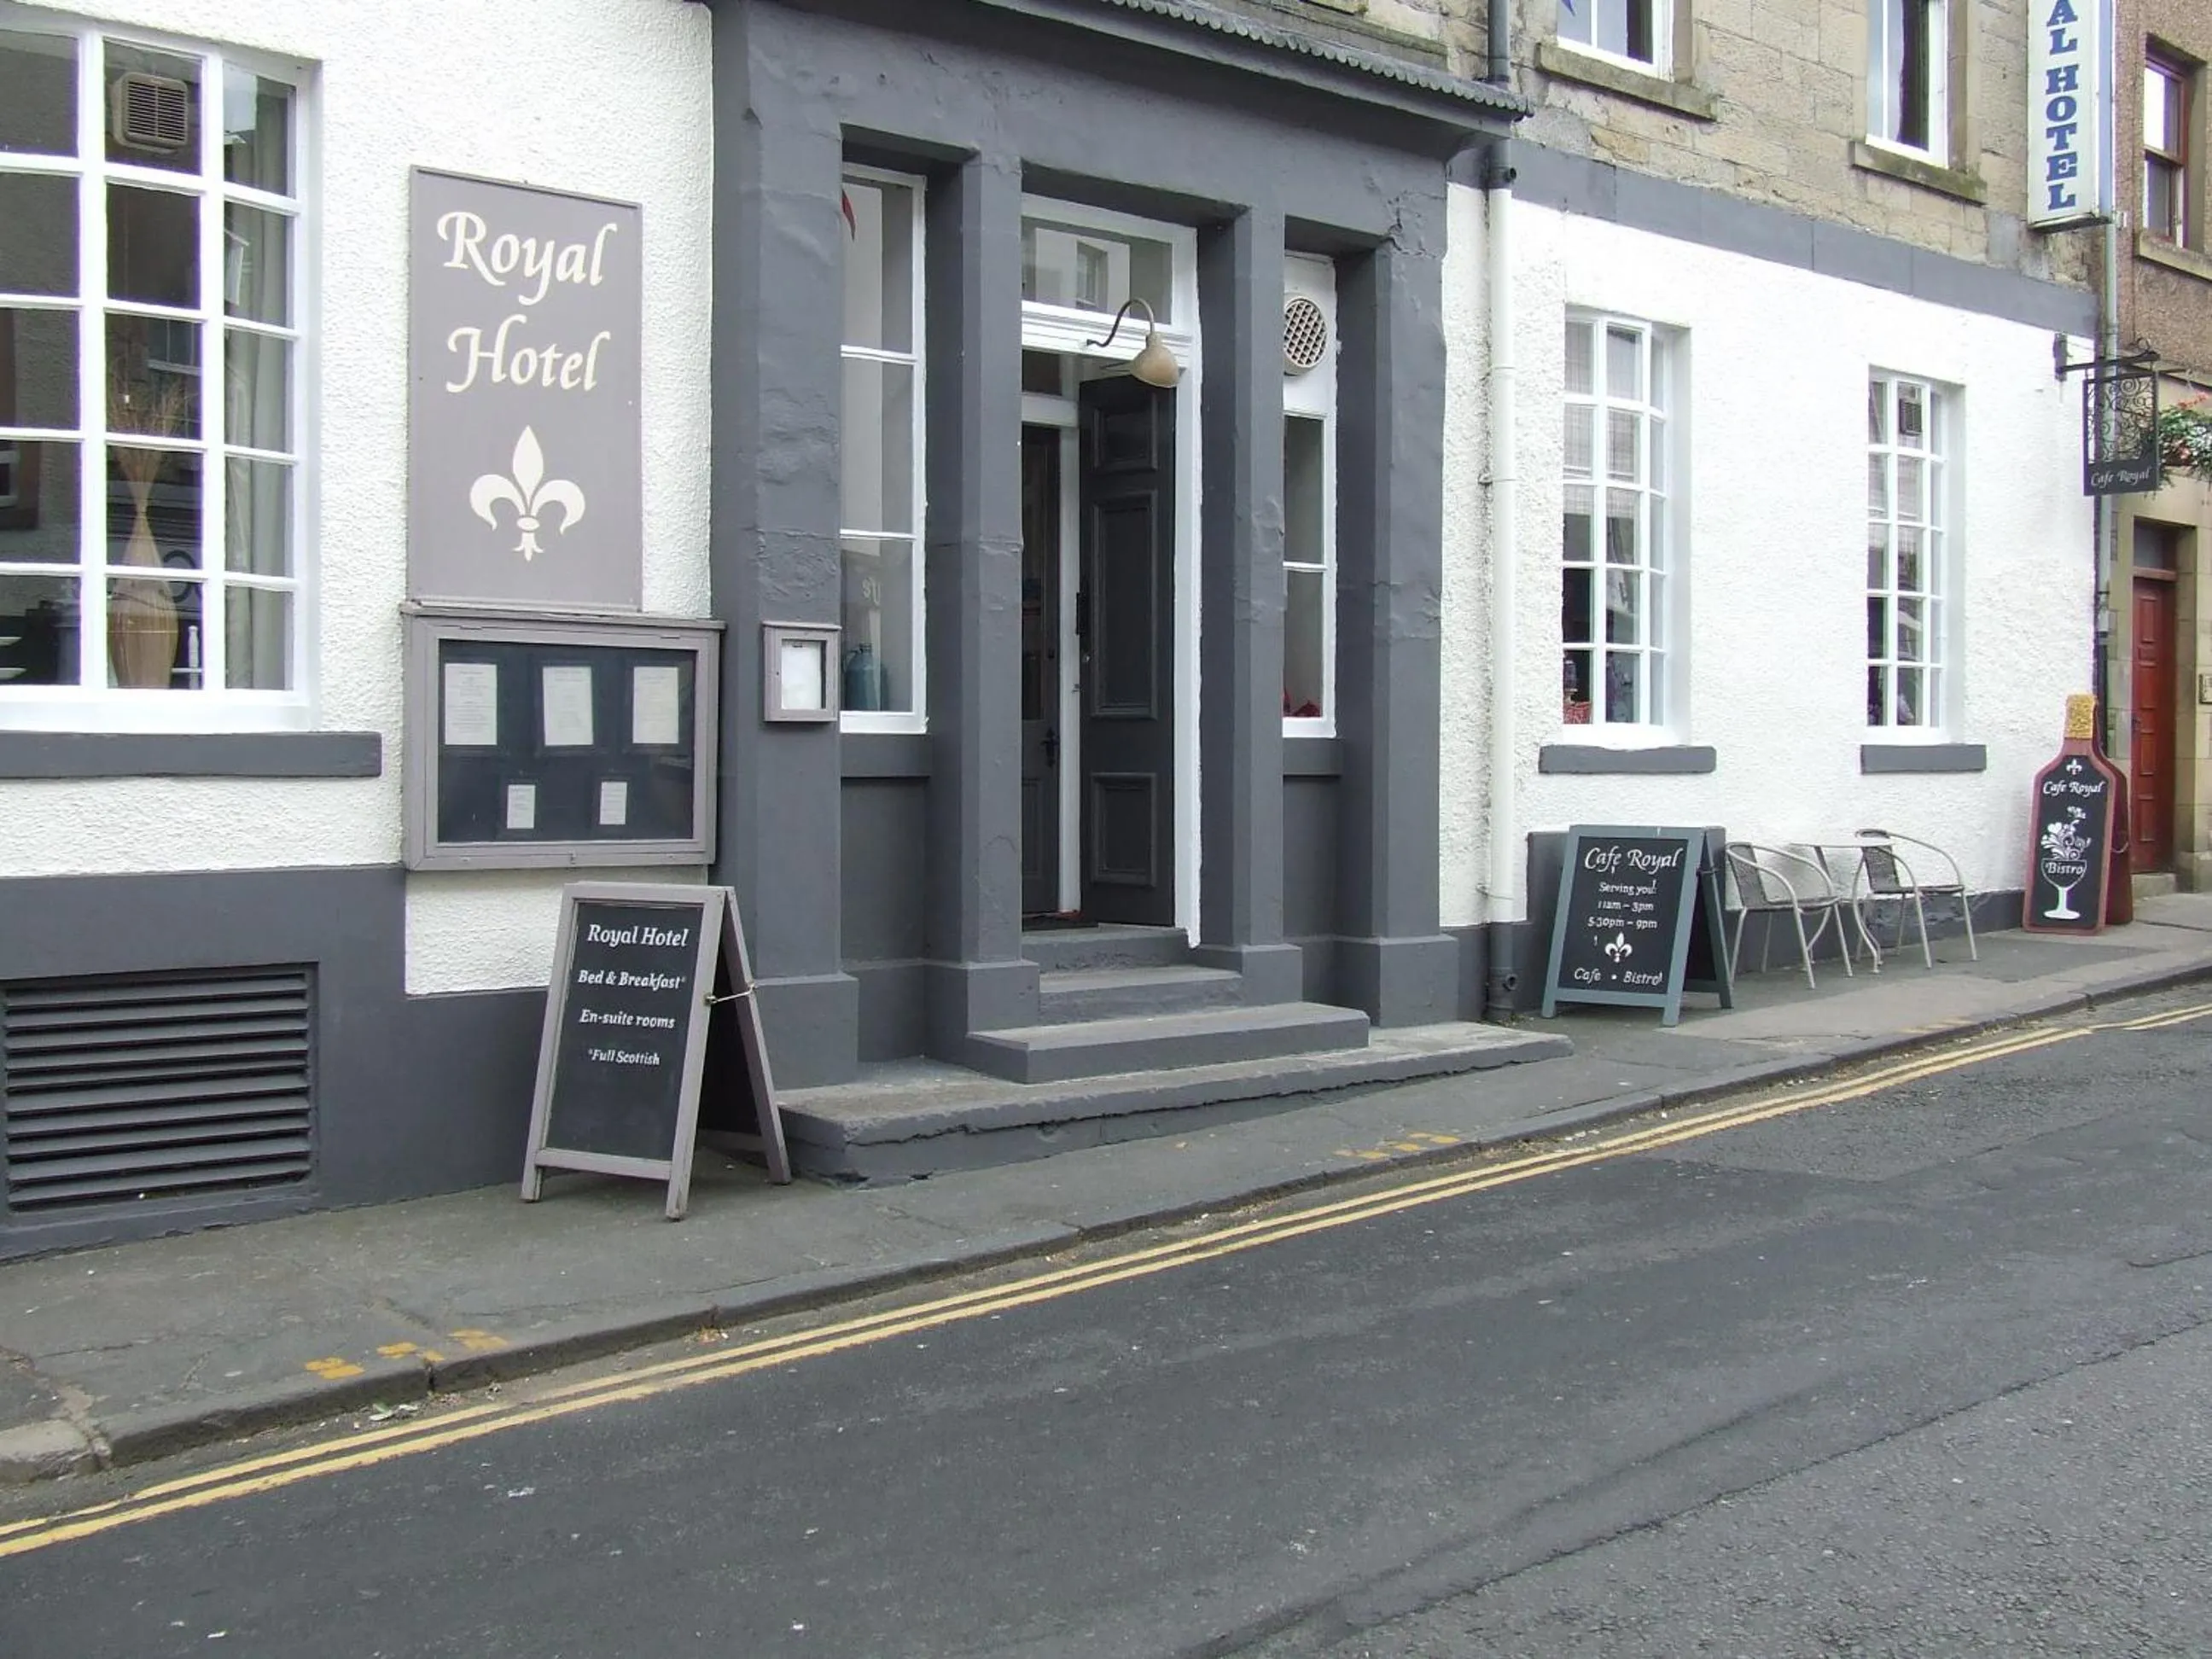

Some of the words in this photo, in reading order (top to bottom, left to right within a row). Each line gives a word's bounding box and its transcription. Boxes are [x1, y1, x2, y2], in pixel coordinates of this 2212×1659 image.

[2046, 63, 2079, 211] HOTEL
[437, 211, 617, 306] Royal
[445, 314, 611, 393] Hotel
[2116, 467, 2151, 486] Royal
[2043, 780, 2067, 796] Cafe
[2069, 780, 2105, 797] Royal
[1585, 846, 1621, 872] Cafe
[1627, 847, 1683, 875] Royal
[2048, 862, 2083, 875] Bistro
[1598, 882, 1634, 895] Serving
[1598, 900, 1621, 910] 11am
[1632, 902, 1654, 913] 3pm
[1636, 919, 1657, 929] 9pm
[586, 924, 638, 947] Royal
[641, 927, 689, 947] Hotel
[578, 969, 604, 984] Bed
[605, 971, 616, 985] &
[1575, 968, 1601, 984] Cafe
[1623, 970, 1662, 986] Bistro
[579, 1010, 633, 1026] En-suite
[636, 1016, 675, 1028] rooms
[616, 1051, 661, 1066] Scottish
